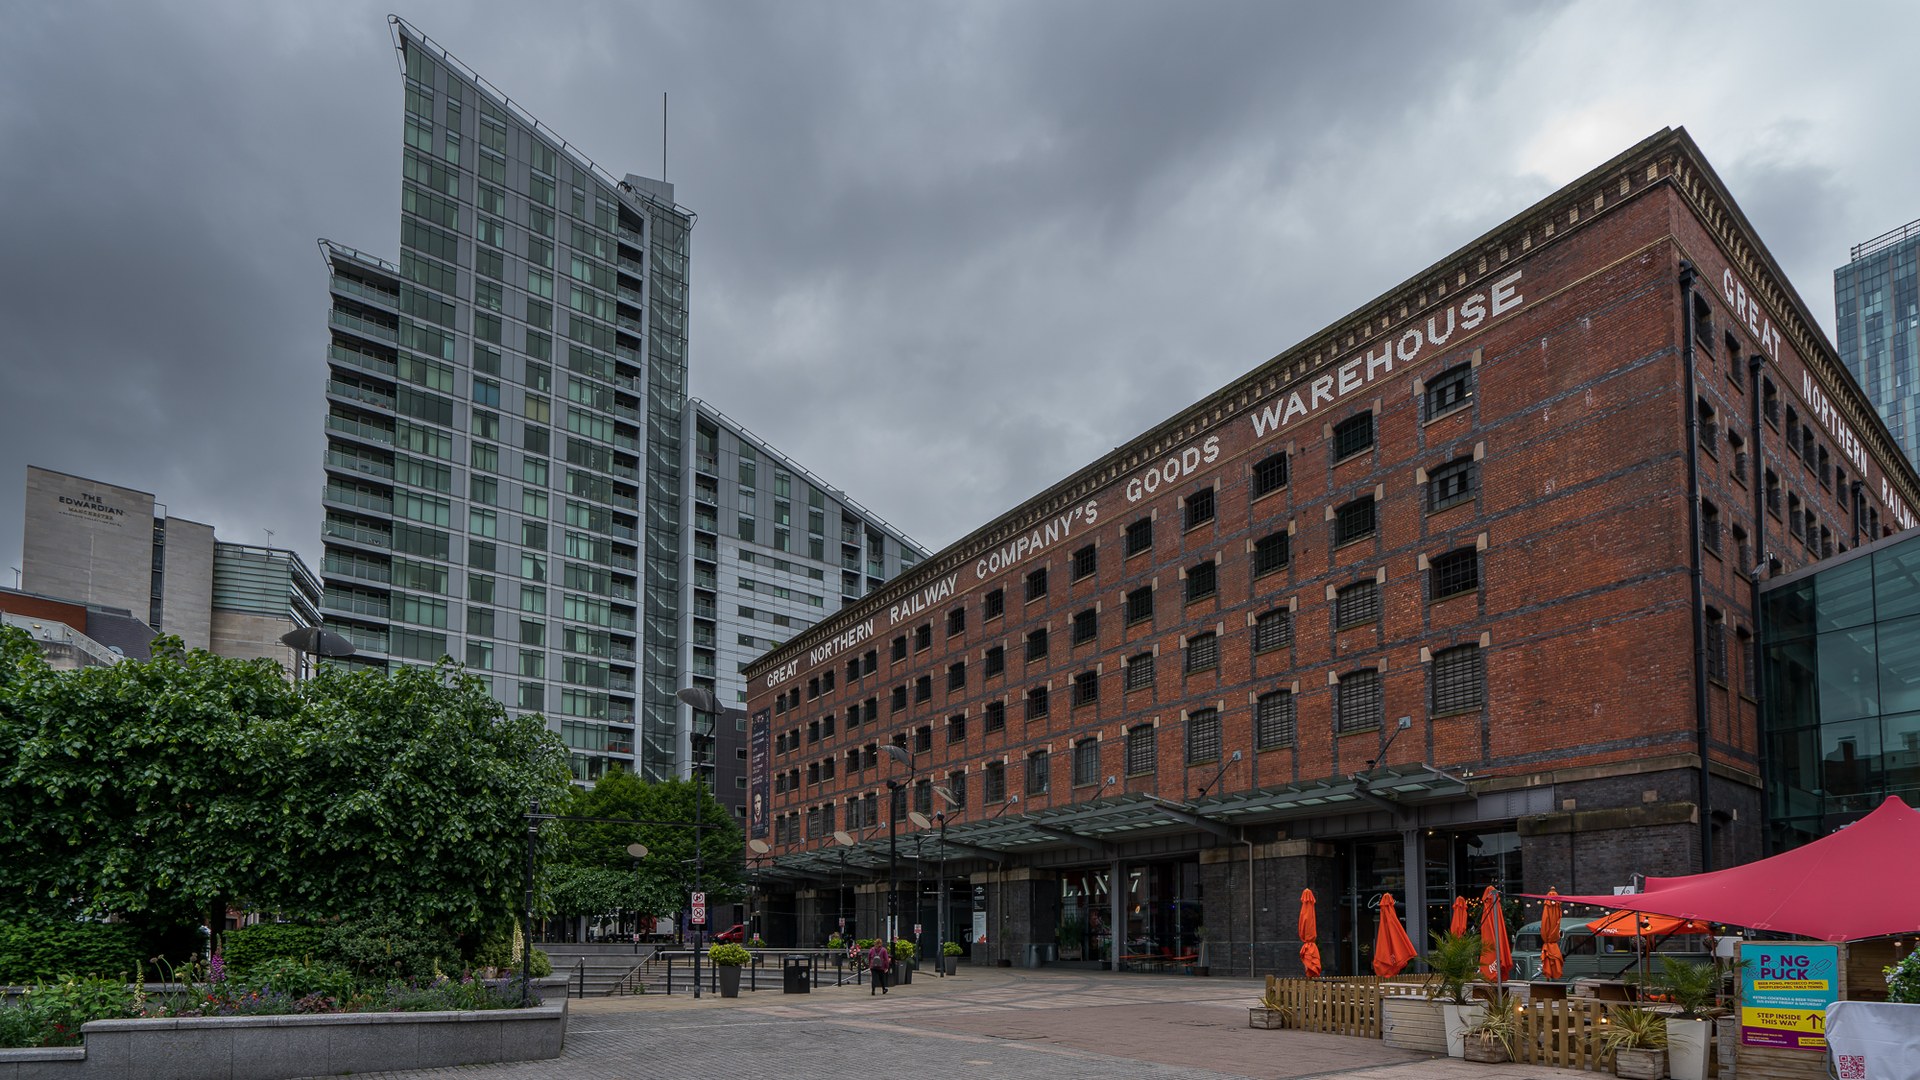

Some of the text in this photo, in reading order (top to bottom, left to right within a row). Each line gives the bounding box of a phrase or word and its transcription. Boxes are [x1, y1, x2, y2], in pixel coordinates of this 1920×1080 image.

[1723, 268, 1918, 529] GREAT NORTHERN RAILWA
[767, 270, 1523, 688] GREAT NORTHERN RAILWAY COMPANY'S GOODS WAREHOUSE
[59, 496, 123, 516] EDWARDIAN
[81, 493, 102, 504] THE
[1760, 968, 1809, 980] PUCK
